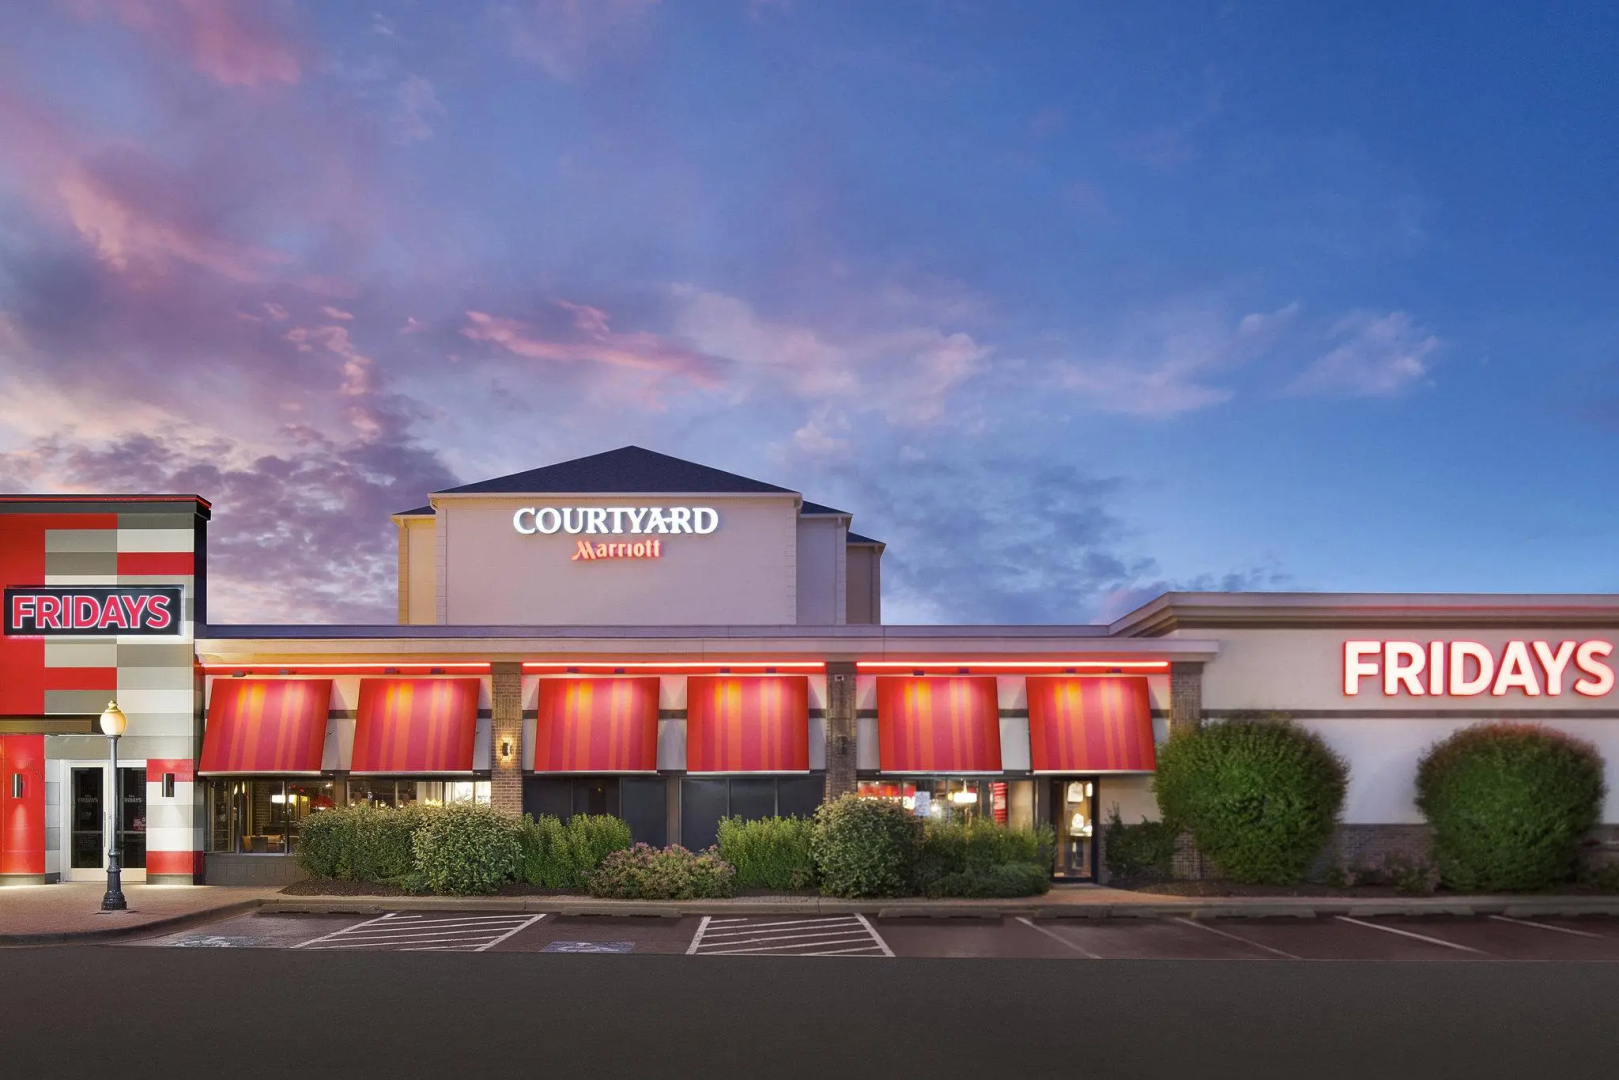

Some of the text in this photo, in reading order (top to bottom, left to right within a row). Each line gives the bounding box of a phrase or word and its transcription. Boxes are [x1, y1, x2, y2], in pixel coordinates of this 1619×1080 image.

[513, 507, 719, 534] COURTYARD
[571, 539, 661, 560] Marriott
[12, 595, 171, 629] FRIDAYS
[1343, 640, 1614, 696] FRIDAYS
